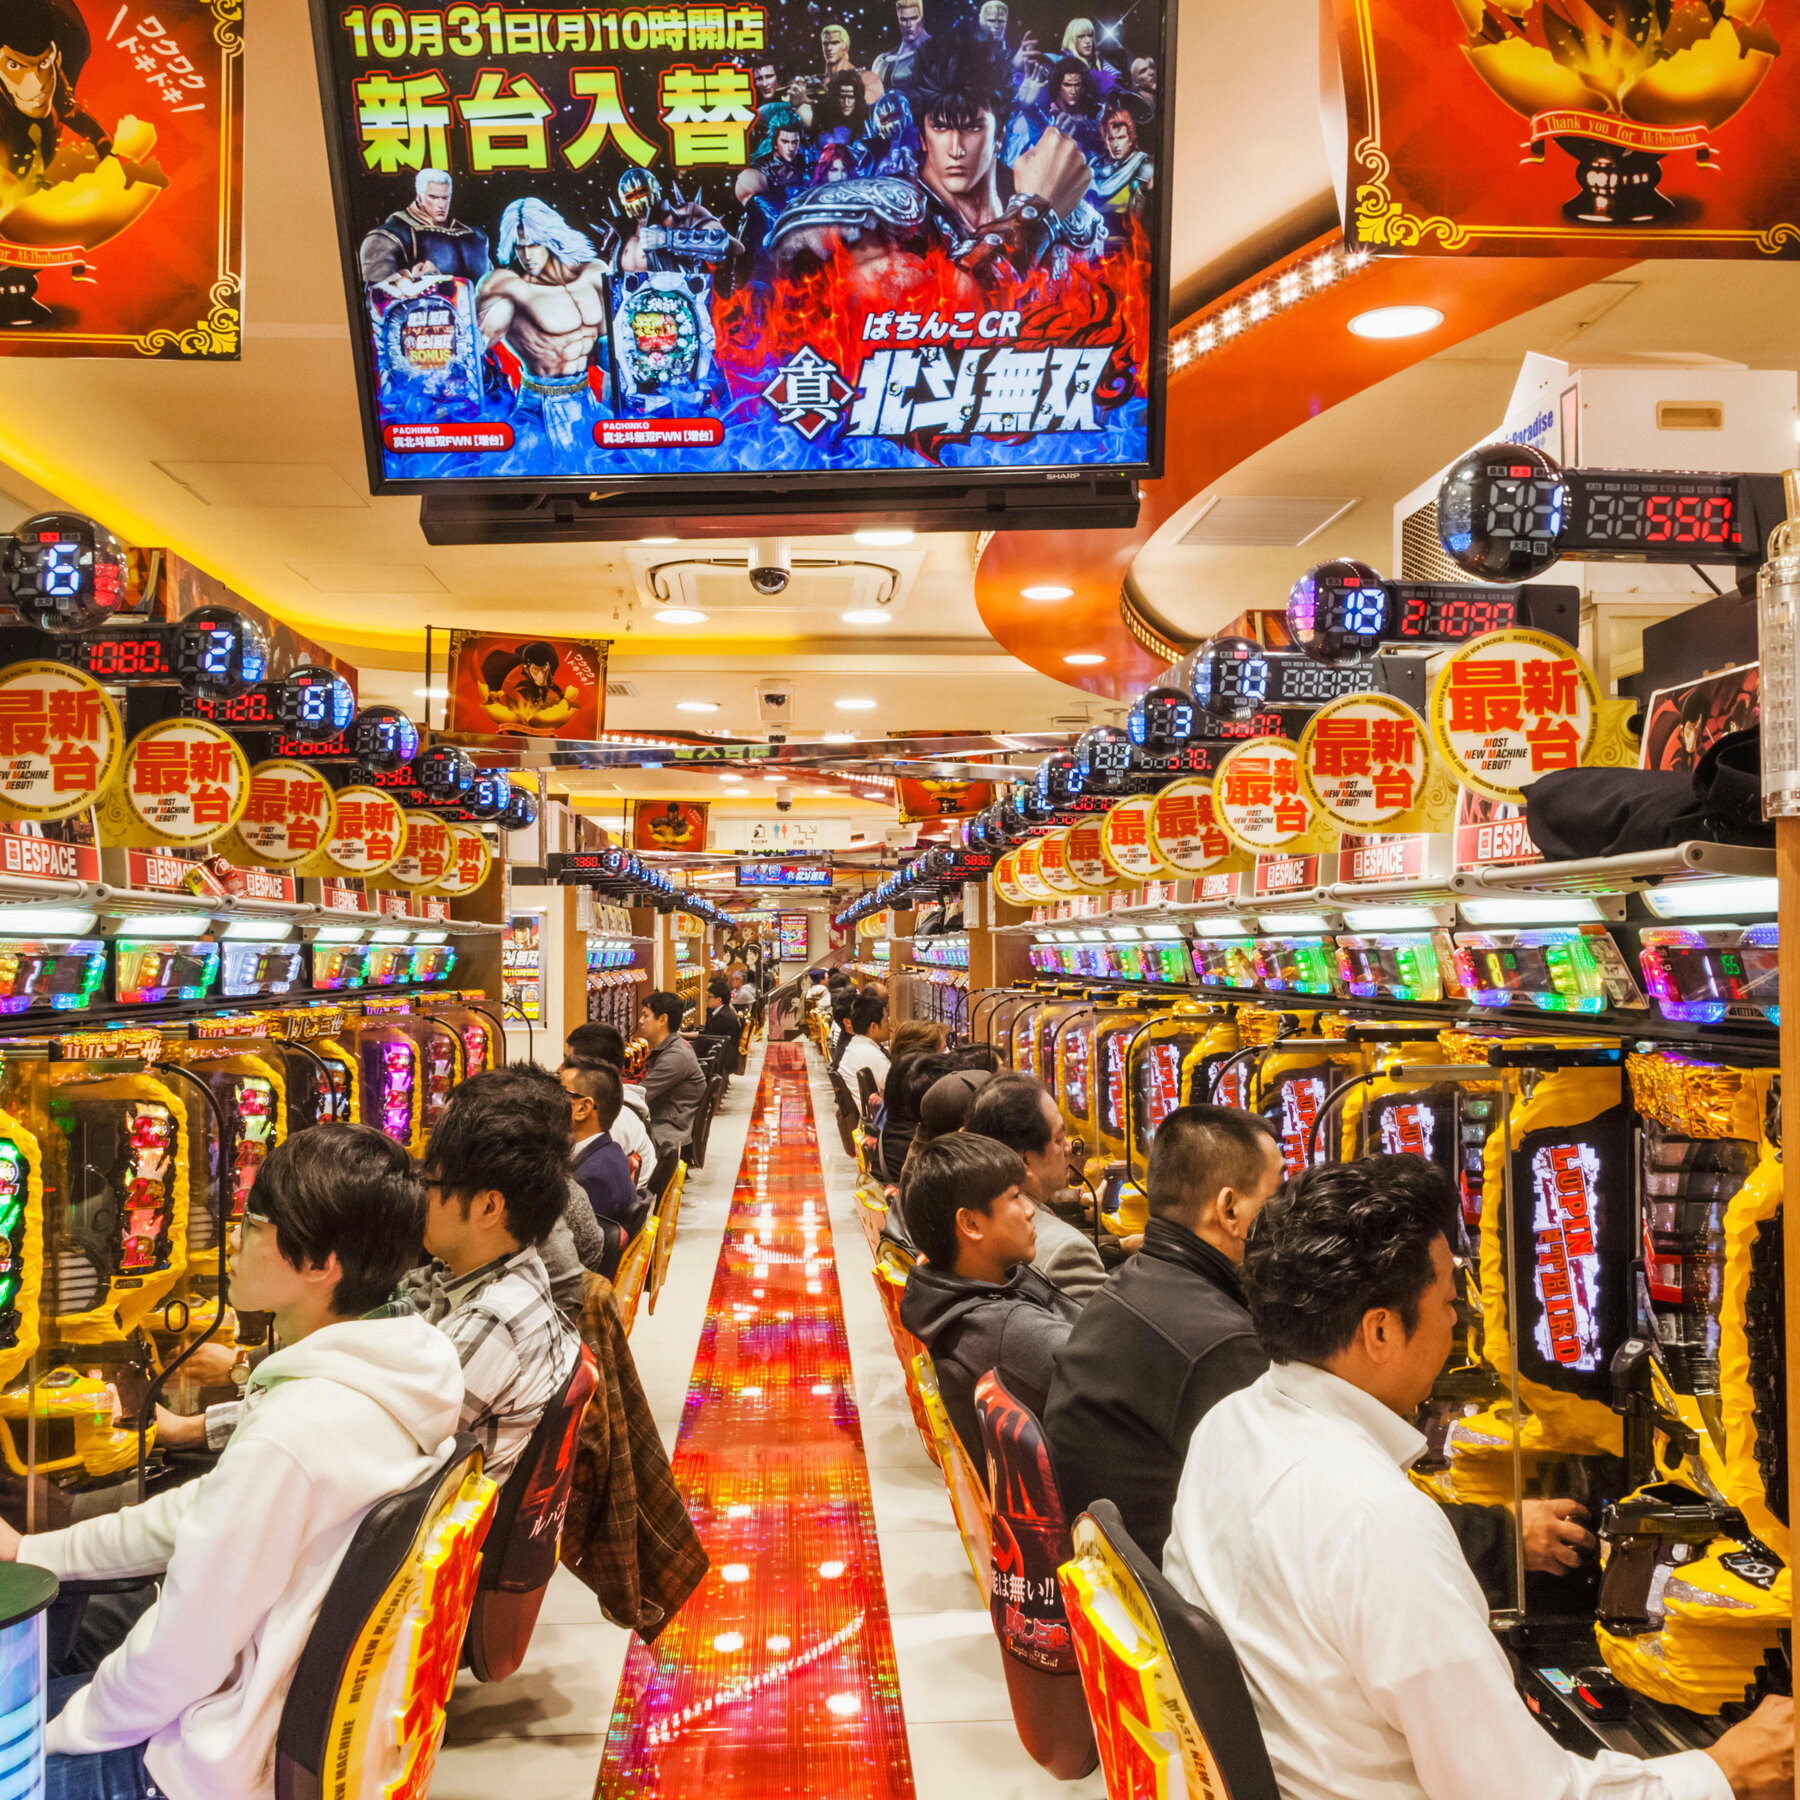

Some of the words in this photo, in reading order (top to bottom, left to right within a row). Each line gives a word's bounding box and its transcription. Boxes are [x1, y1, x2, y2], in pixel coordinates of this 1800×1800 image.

[344, 7, 765, 58] 10月31日(月)10時開店
[136, 15, 207, 90] ワクワク
[116, 36, 184, 104] ドキドキ
[356, 65, 757, 173] 新台入替
[1544, 116, 1581, 132] Thank
[1588, 120, 1609, 134] you
[1616, 125, 1634, 142] for
[862, 309, 1022, 341] ぱちんこCR
[777, 359, 839, 424] 真
[845, 345, 1113, 436] 北斗無双
[392, 427, 439, 435] PACHINKO
[603, 422, 650, 430] PACHINKO
[1046, 473, 1080, 481] SHARP
[573, 653, 596, 678] ワクワク
[1464, 749, 1487, 760] NEW
[1487, 748, 1528, 759] MACHINE
[1483, 738, 1508, 749] MOST
[9, 760, 32, 770] MOST
[11, 770, 50, 780] MACHINE
[1481, 759, 1511, 771] DEBUT!
[5, 780, 34, 790] DEBUT!
[1322, 790, 1341, 798] NEW
[1341, 790, 1373, 798] MACHINE
[1338, 781, 1359, 789] MOST
[160, 806, 191, 814] MACHINE
[1335, 798, 1360, 807] DEBUT!
[21, 839, 78, 878] ESPACE
[1363, 845, 1404, 877] ESPACE
[1274, 860, 1305, 887] ESPACE
[254, 874, 283, 899] ESPACE
[1550, 1144, 1595, 1258] LUPIN
[1539, 1242, 1582, 1364] THIRD
[348, 1668, 369, 1705] MOST
[361, 1638, 381, 1666] NEW
[373, 1576, 414, 1635] MACHINE
[335, 1718, 356, 1781] MACHINE
[1164, 1697, 1196, 1746] MOST
[1191, 1749, 1212, 1788] NEW
